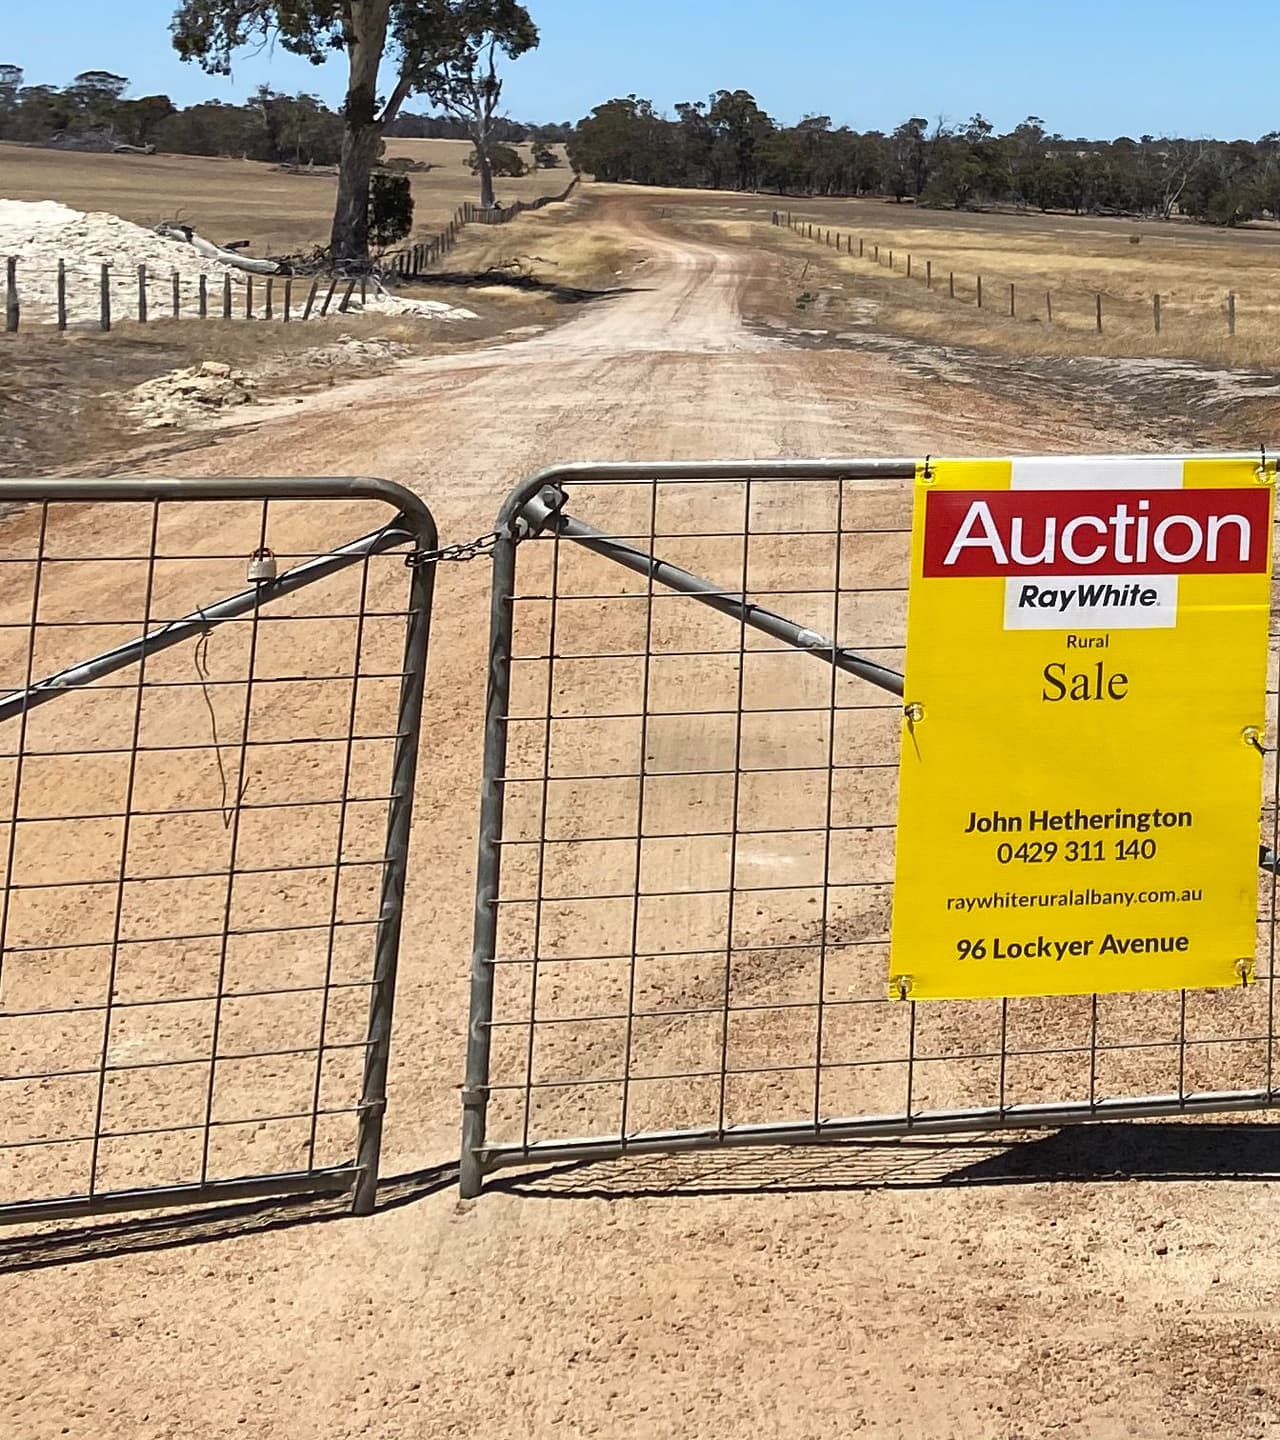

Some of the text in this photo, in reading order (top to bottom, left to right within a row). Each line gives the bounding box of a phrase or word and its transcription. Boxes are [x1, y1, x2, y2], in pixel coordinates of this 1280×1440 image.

[943, 500, 1251, 566] Auction
[1066, 634, 1109, 649] Rural
[1042, 662, 1129, 702] Sale
[965, 808, 1193, 833] John Hetherington
[997, 839, 1156, 864] 0429 311 140
[946, 888, 1203, 912] raywhiteruralalbany.com.au
[956, 933, 1189, 961] 96 Lockyer Avenue
